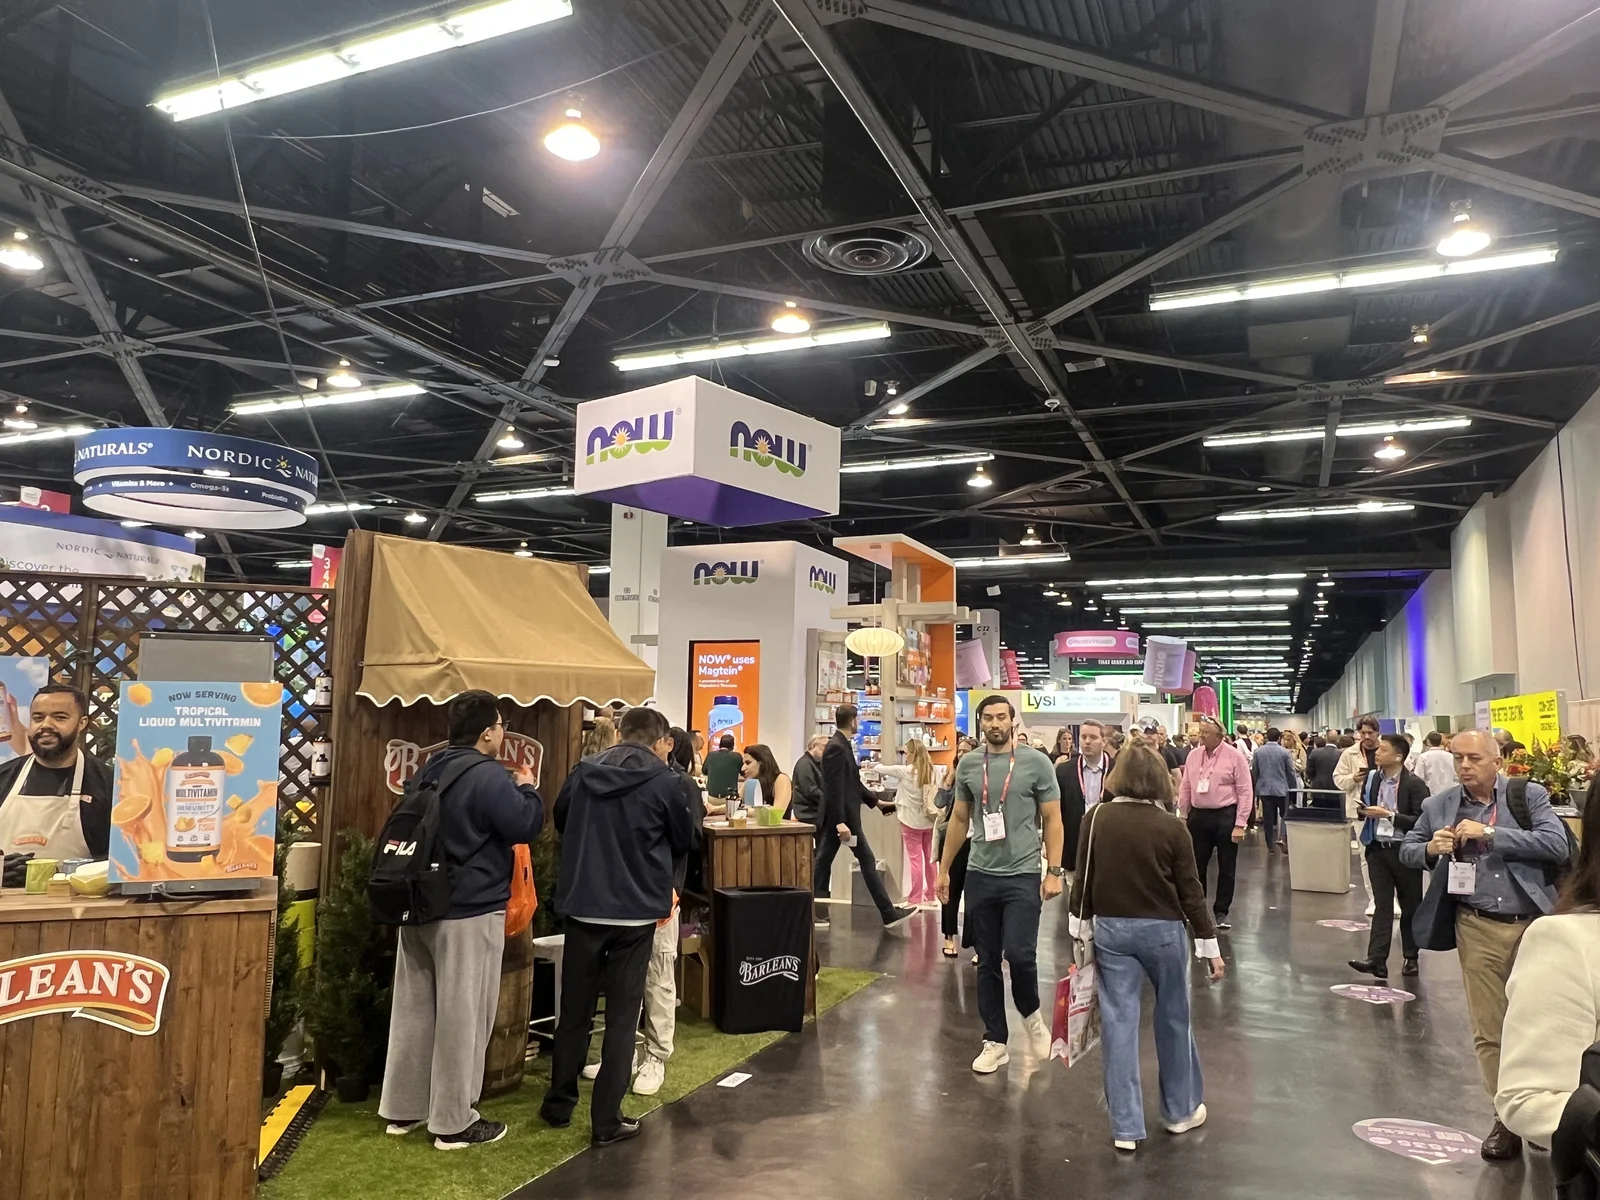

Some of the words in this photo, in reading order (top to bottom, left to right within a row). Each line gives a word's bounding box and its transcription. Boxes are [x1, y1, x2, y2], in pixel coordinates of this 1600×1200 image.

[187, 444, 273, 470] NORDIC
[56, 542, 100, 556] NORDIC
[732, 656, 755, 664] uses
[168, 691, 192, 703] NOW
[195, 690, 237, 703] SERVING
[174, 706, 229, 716] TROPICAL
[139, 717, 176, 727] LIQUID
[179, 717, 262, 727] MULTIVITAMIN
[383, 839, 418, 856] FILA
